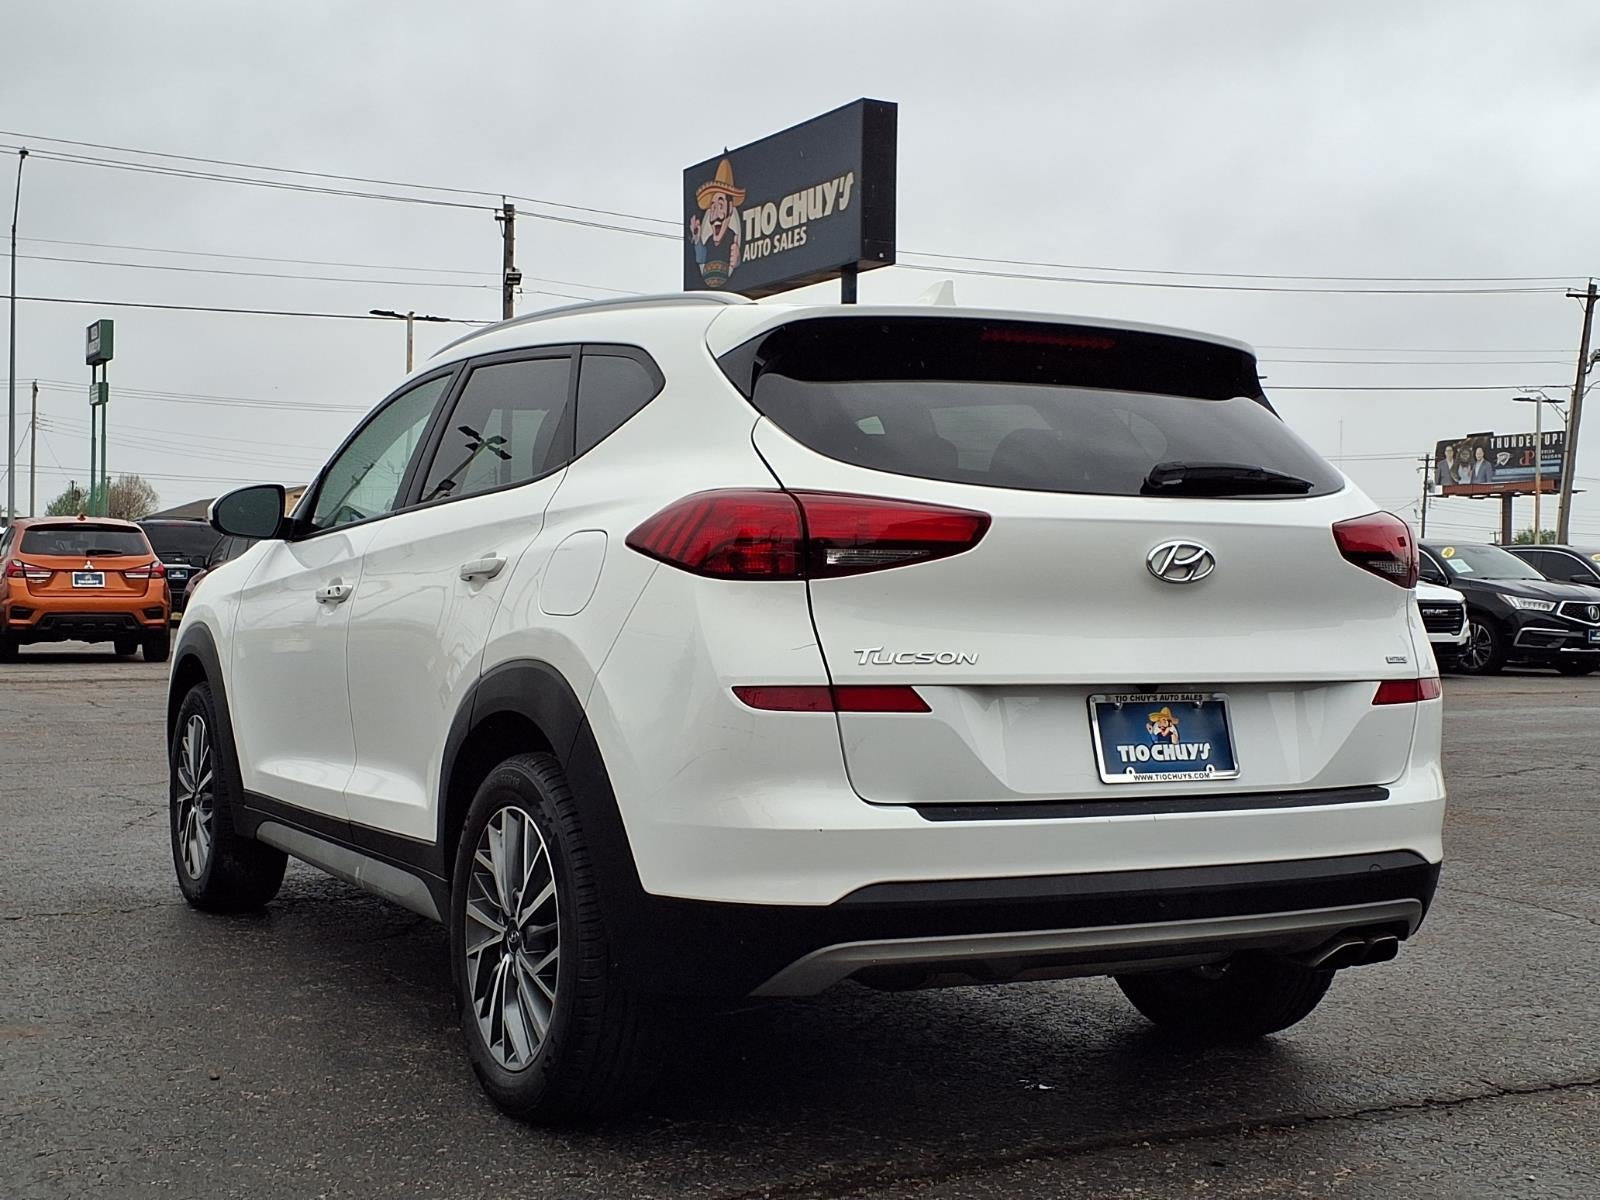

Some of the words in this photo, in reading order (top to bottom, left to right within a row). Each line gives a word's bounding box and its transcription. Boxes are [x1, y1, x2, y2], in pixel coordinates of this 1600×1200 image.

[742, 202, 778, 241] TIO
[778, 172, 854, 229] CHUY'S
[742, 240, 771, 263] AUTO
[773, 226, 807, 254] SALES
[1544, 432, 1563, 446] UP!
[1129, 694, 1158, 702] CHUY'S
[1180, 693, 1203, 701] SALES
[1116, 743, 1150, 763] TIO
[1151, 742, 1211, 762] CHUY'S
[1133, 772, 1211, 782] WWW.TIOCHUYS.COM
